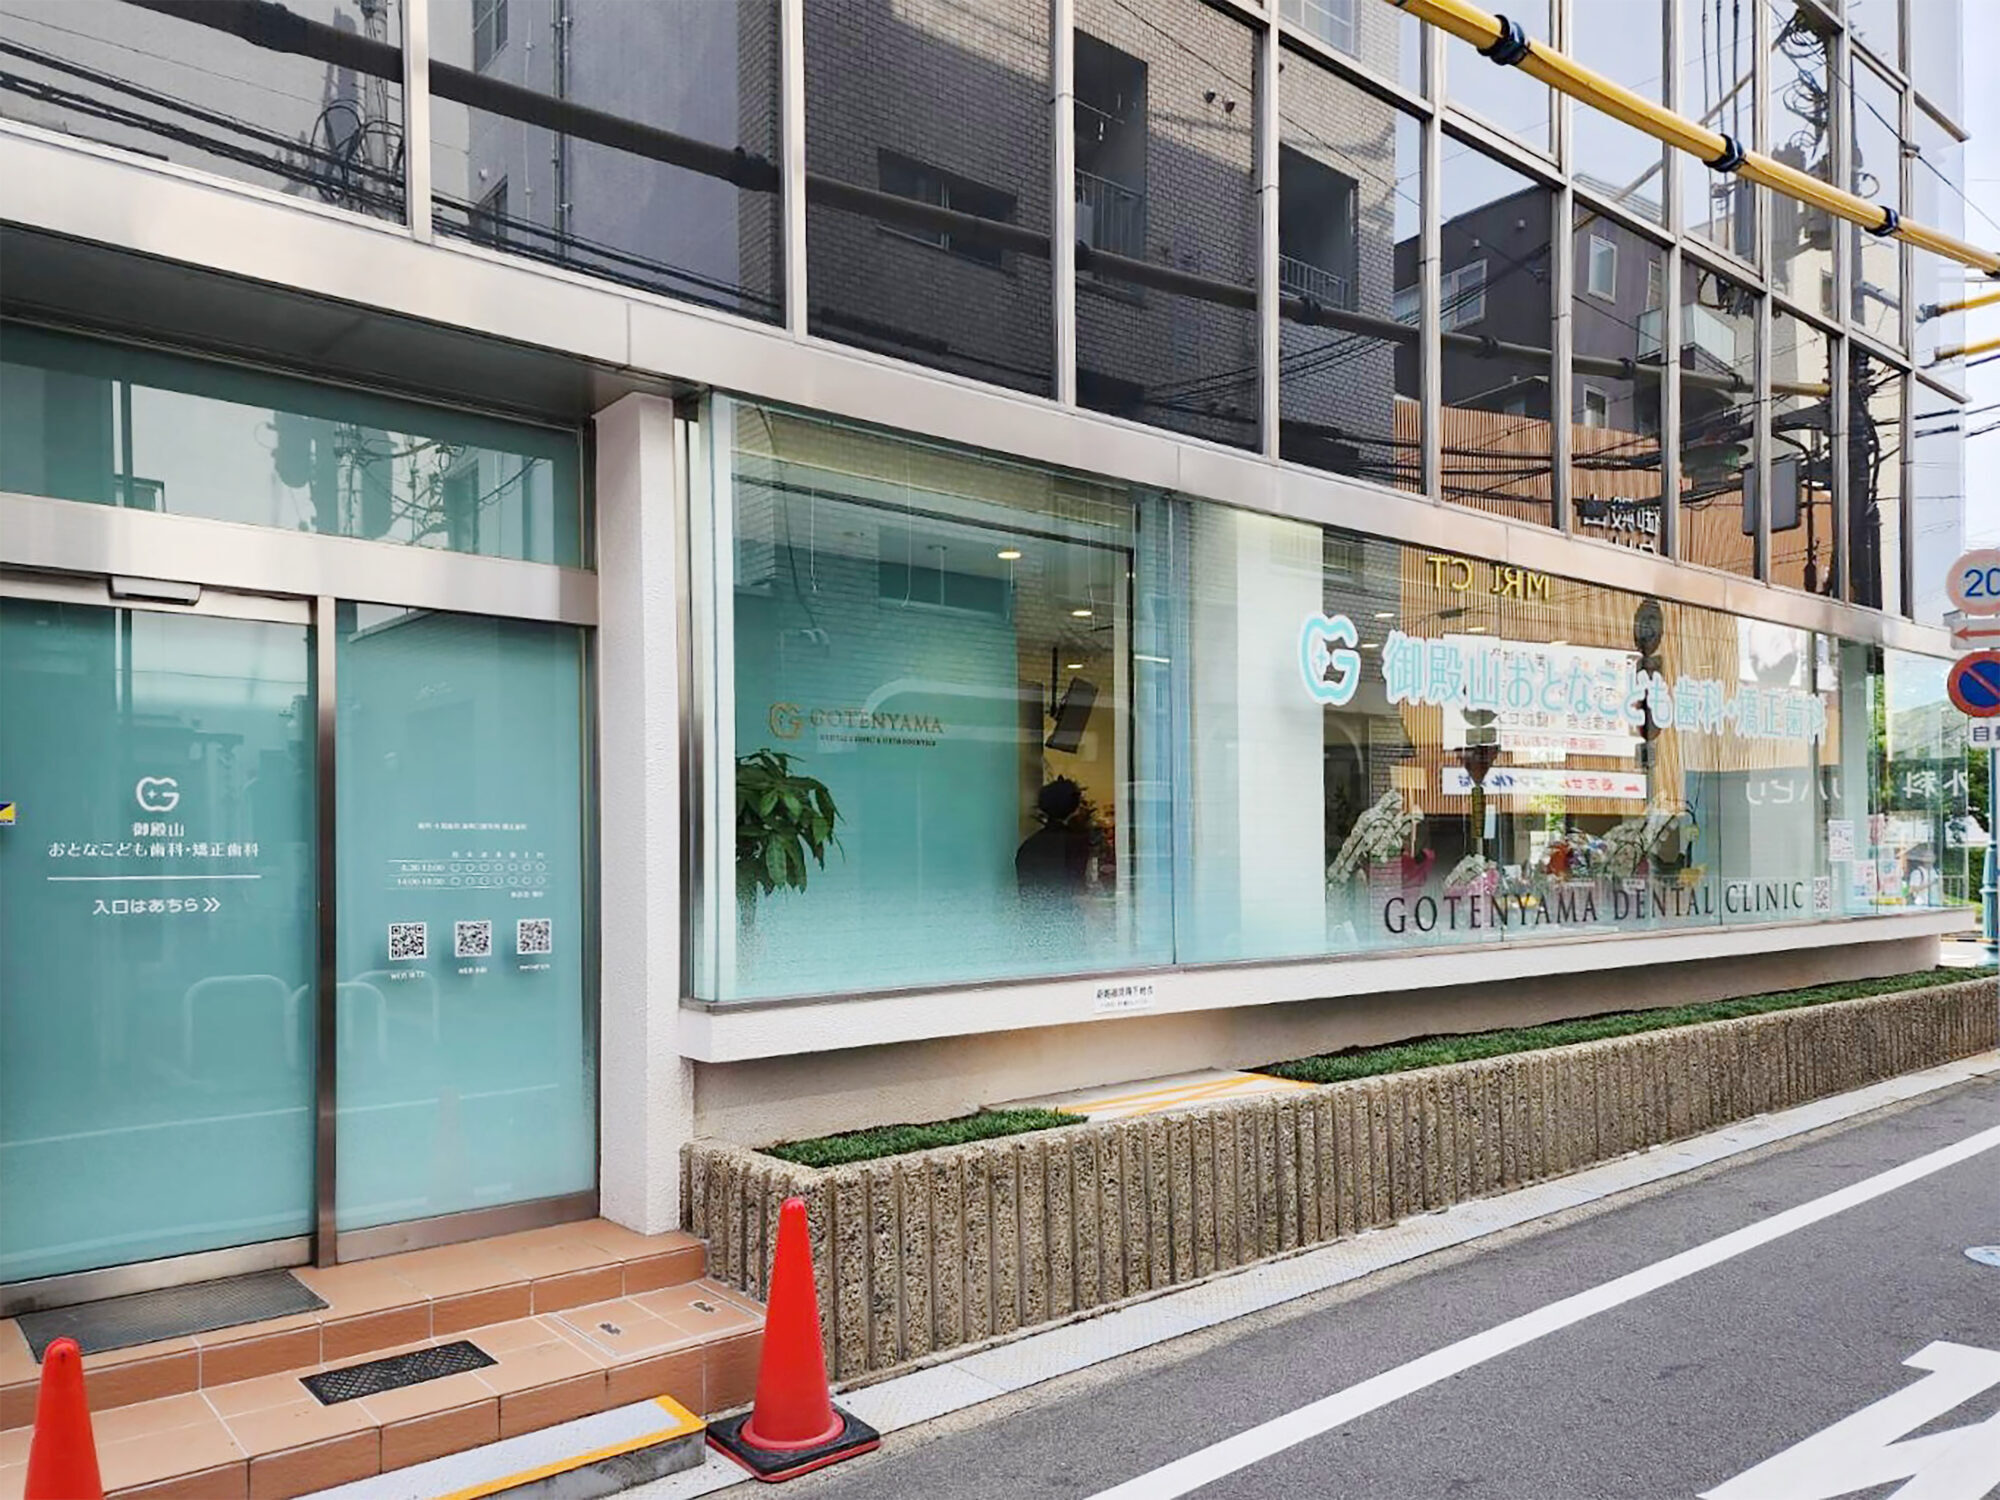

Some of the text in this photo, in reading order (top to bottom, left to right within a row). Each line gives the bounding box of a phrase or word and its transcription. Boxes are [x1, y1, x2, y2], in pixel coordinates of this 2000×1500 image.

[1964, 567, 2000, 597] 20
[809, 708, 944, 734] GOTENYAMA
[1973, 726, 2000, 742] 自
[132, 821, 185, 838] 御殿山
[48, 842, 259, 858] おとなこども歯科・矯正歯科
[92, 897, 199, 915] 入口はあちら
[1384, 881, 1805, 934] GOTENYAMA DENTAL CLINIC
